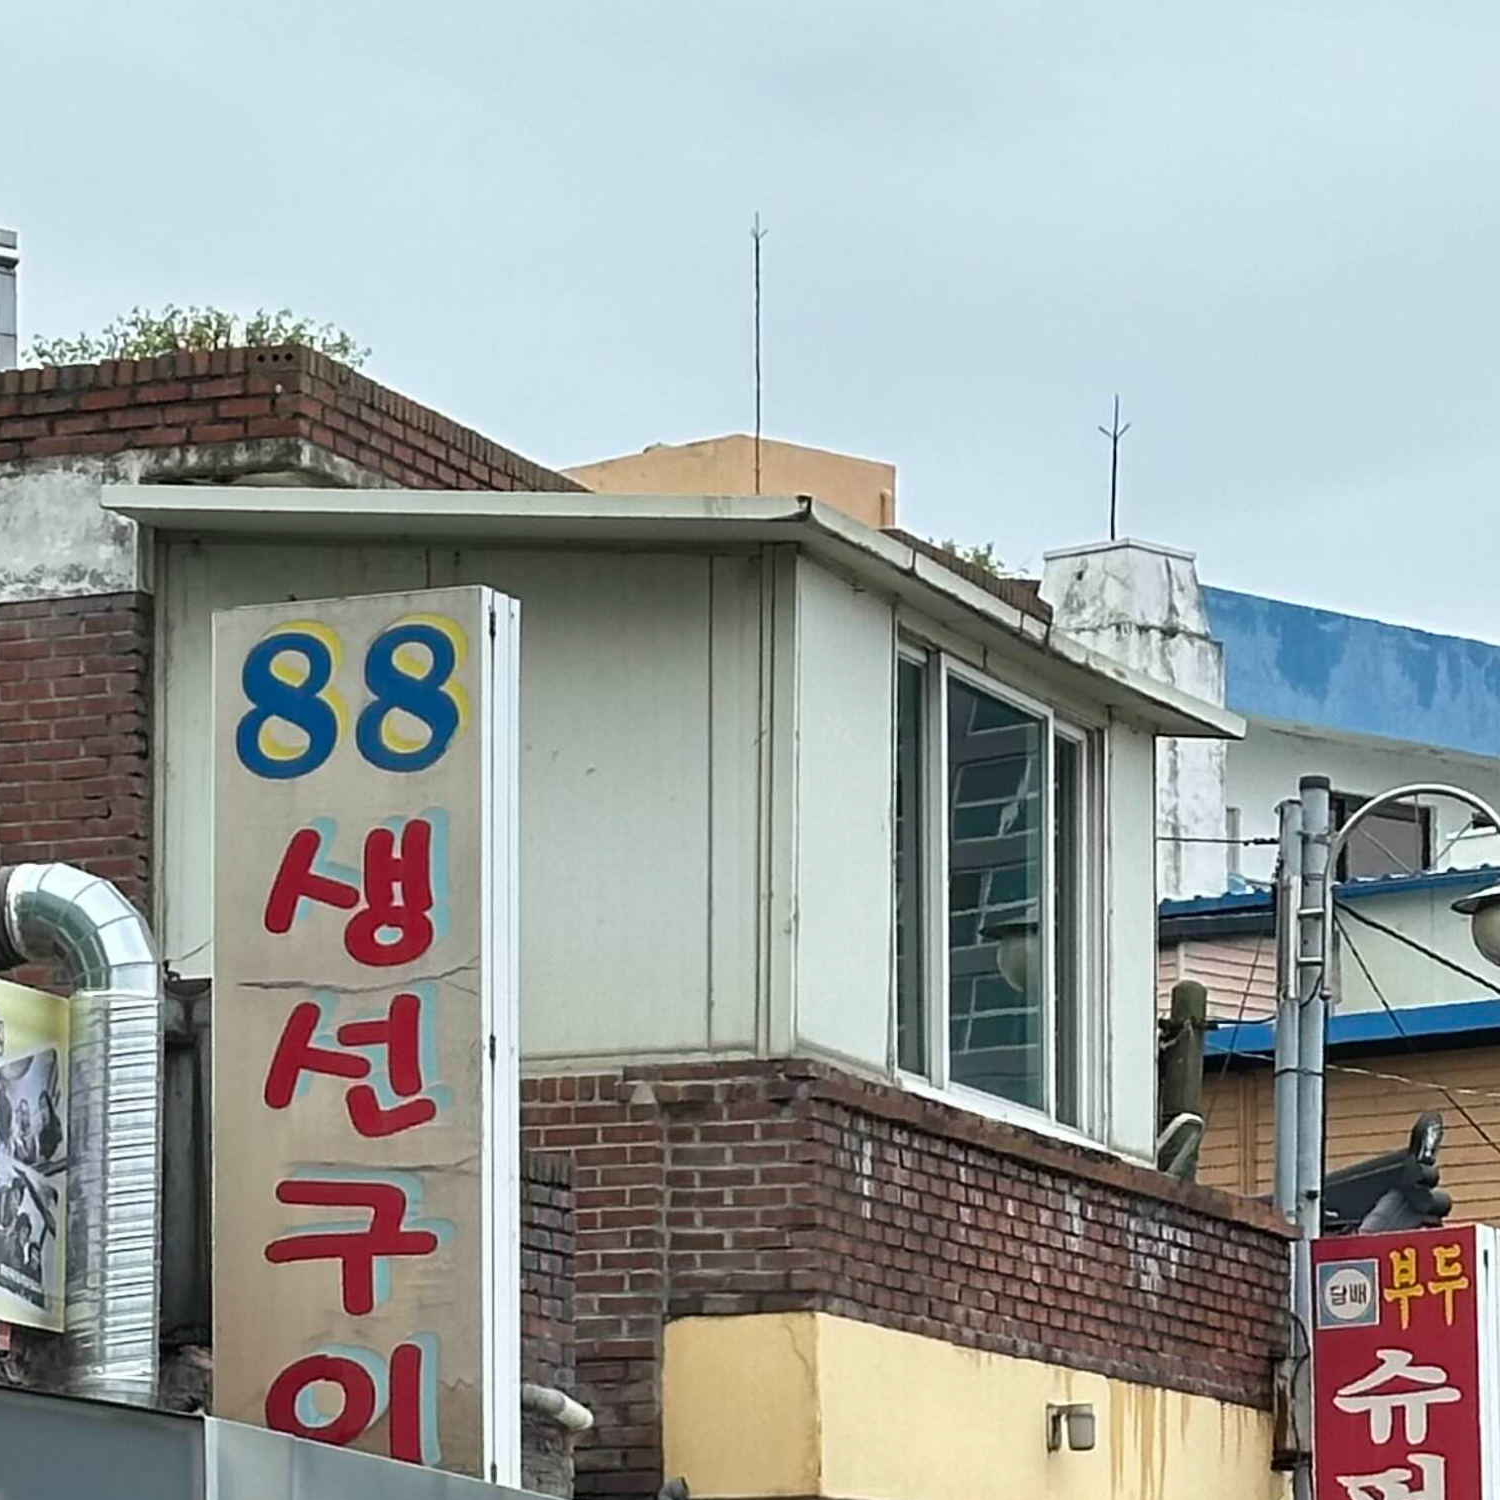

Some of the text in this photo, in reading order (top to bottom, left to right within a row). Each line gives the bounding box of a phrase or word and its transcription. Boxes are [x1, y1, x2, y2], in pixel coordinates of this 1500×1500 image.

[236, 613, 469, 780] 88
[263, 808, 450, 1466] 생선구이
[1330, 1285, 1367, 1306] 담배
[1383, 1244, 1469, 1331] 부두
